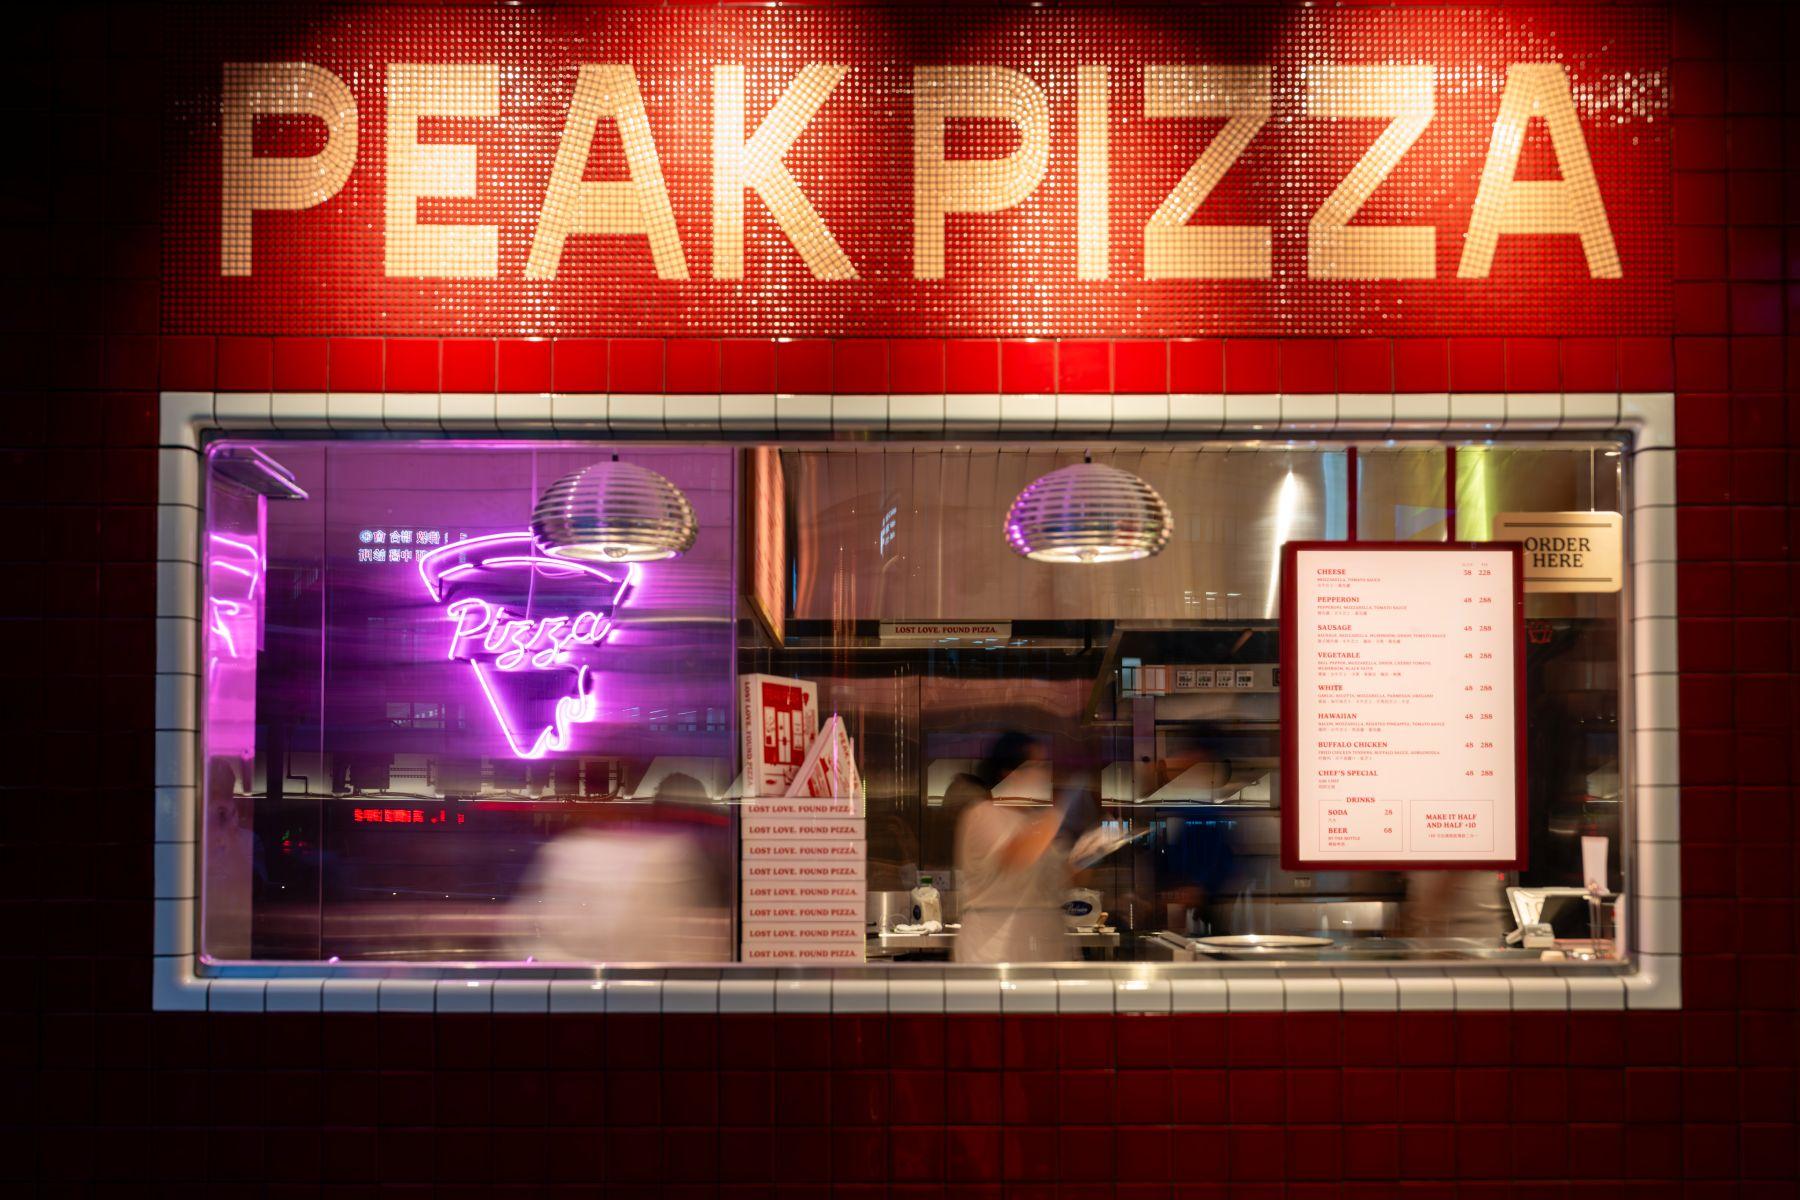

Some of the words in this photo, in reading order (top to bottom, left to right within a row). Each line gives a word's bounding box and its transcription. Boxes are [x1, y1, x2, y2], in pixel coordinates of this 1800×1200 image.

[221, 61, 861, 280] PEAK
[913, 62, 1623, 280] PIZZA
[1524, 536, 1591, 552] ORDER
[1533, 553, 1585, 568] HERE
[1317, 568, 1346, 576] CHEESE
[447, 597, 612, 670] Pizza
[895, 626, 915, 634] LOST
[942, 626, 970, 634] FOUND
[1347, 769, 1379, 777] SPECIAL
[748, 805, 770, 813] LOST
[772, 805, 797, 813] LOVE.
[798, 805, 828, 813] FOUND
[749, 826, 771, 834] LOST
[773, 826, 797, 834] LOVE.
[799, 826, 829, 834] FOUND
[830, 826, 857, 834] PIZZA.
[749, 847, 771, 855] LOST
[773, 847, 797, 855] LOVE.
[799, 847, 829, 855] FOUND
[830, 847, 857, 855] PIZZA.
[749, 868, 771, 876] LOST
[773, 868, 797, 876] LOVE.
[799, 868, 829, 876] FOUND
[830, 868, 857, 876] PIZZA.
[749, 888, 771, 896] LOST
[773, 888, 797, 896] LOVE.
[799, 888, 829, 896] FOUND
[830, 888, 857, 896] PIZZA.
[749, 909, 771, 917] LOST
[773, 909, 797, 917] LOVE.
[799, 909, 829, 917] FOUND
[830, 909, 857, 917] PIZZA.
[749, 929, 771, 937] LOST
[773, 929, 797, 937] LOVE.
[799, 929, 829, 937] FOUND
[830, 929, 857, 937] PIZZA.
[749, 950, 771, 958] LOST
[773, 950, 797, 958] LOVE.
[799, 950, 829, 958] FOUND
[830, 950, 857, 958] PIZZA.
